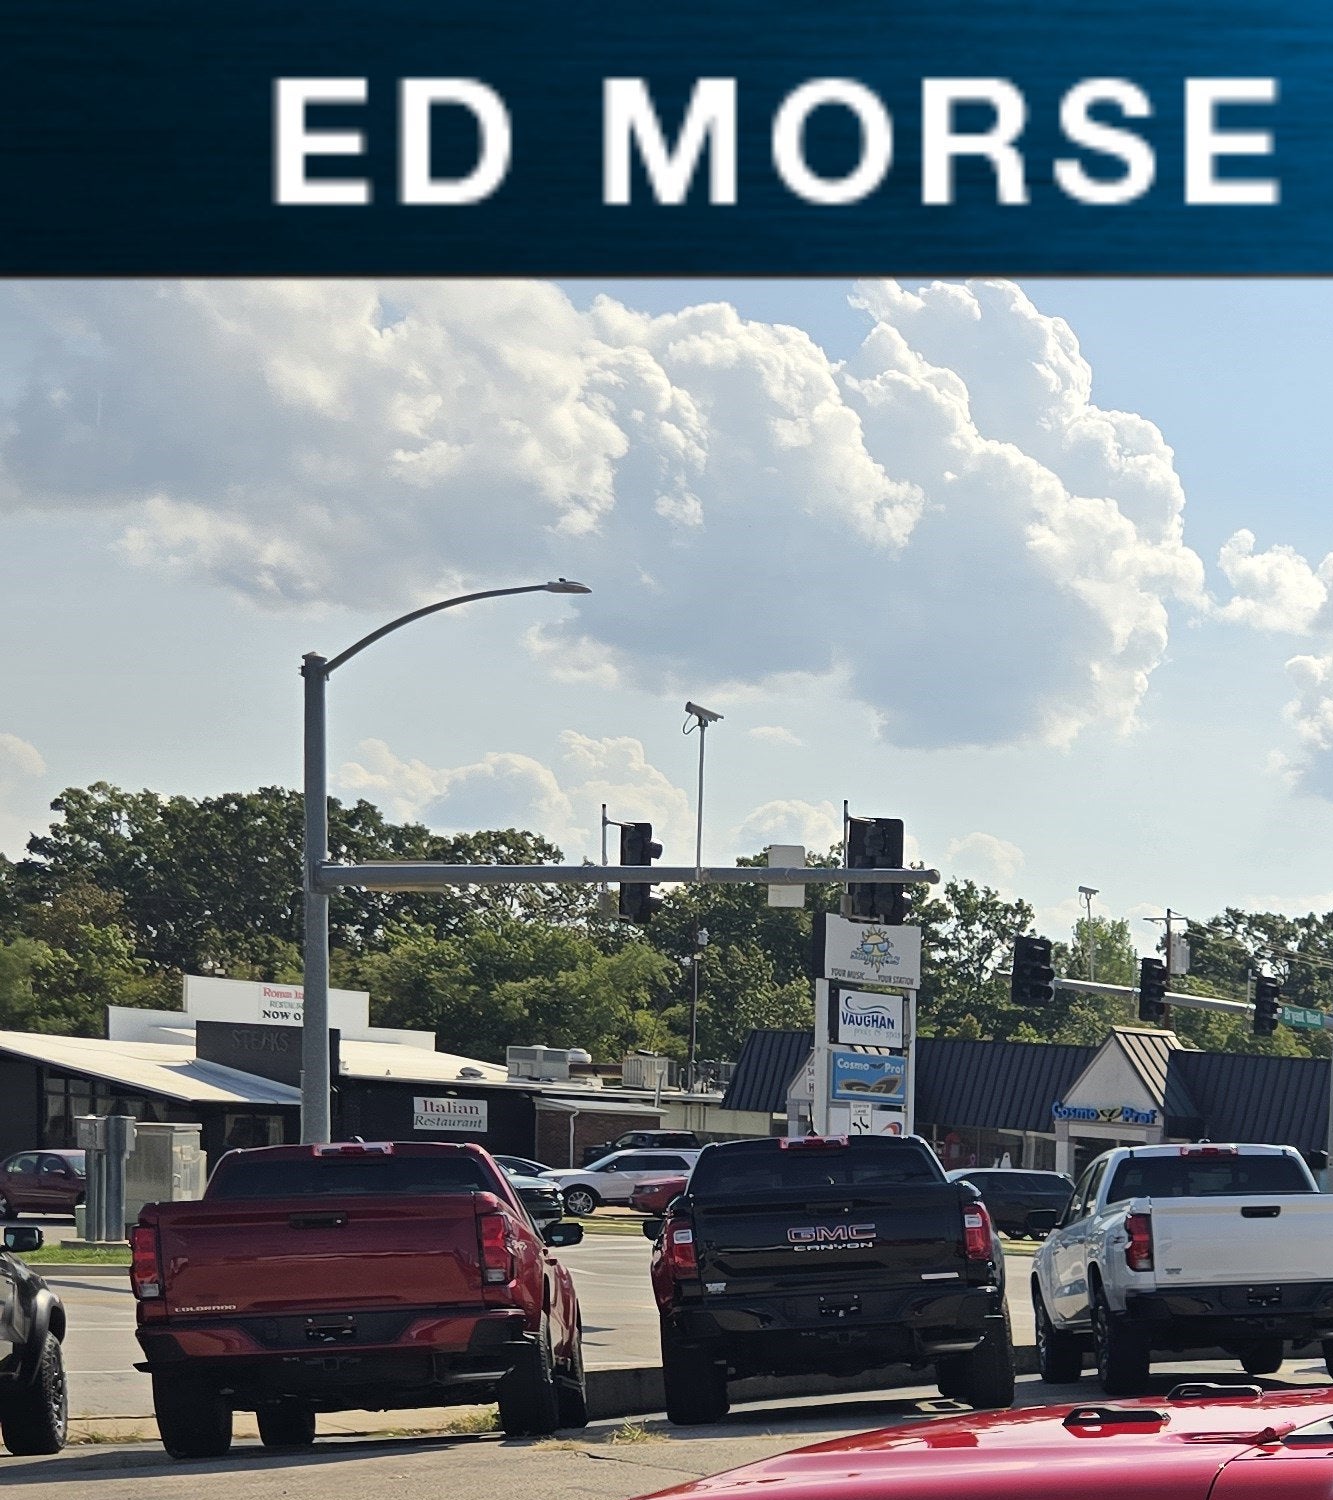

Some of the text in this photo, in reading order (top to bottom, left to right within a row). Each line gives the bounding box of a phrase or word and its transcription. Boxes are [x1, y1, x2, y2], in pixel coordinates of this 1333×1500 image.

[831, 968, 846, 977] YOUR
[878, 975, 892, 983] YOUR
[892, 976, 914, 985] STATION
[263, 1010, 290, 1020] NOW
[842, 1011, 894, 1029] VAUGHAN
[837, 1058, 904, 1074] Cosmo Prof
[423, 1099, 480, 1115] Italian
[1052, 1101, 1157, 1123] Cosmo Prof
[414, 1115, 482, 1128] Restaurant
[787, 1224, 876, 1242] GMC
[794, 1242, 873, 1251] CANYON
